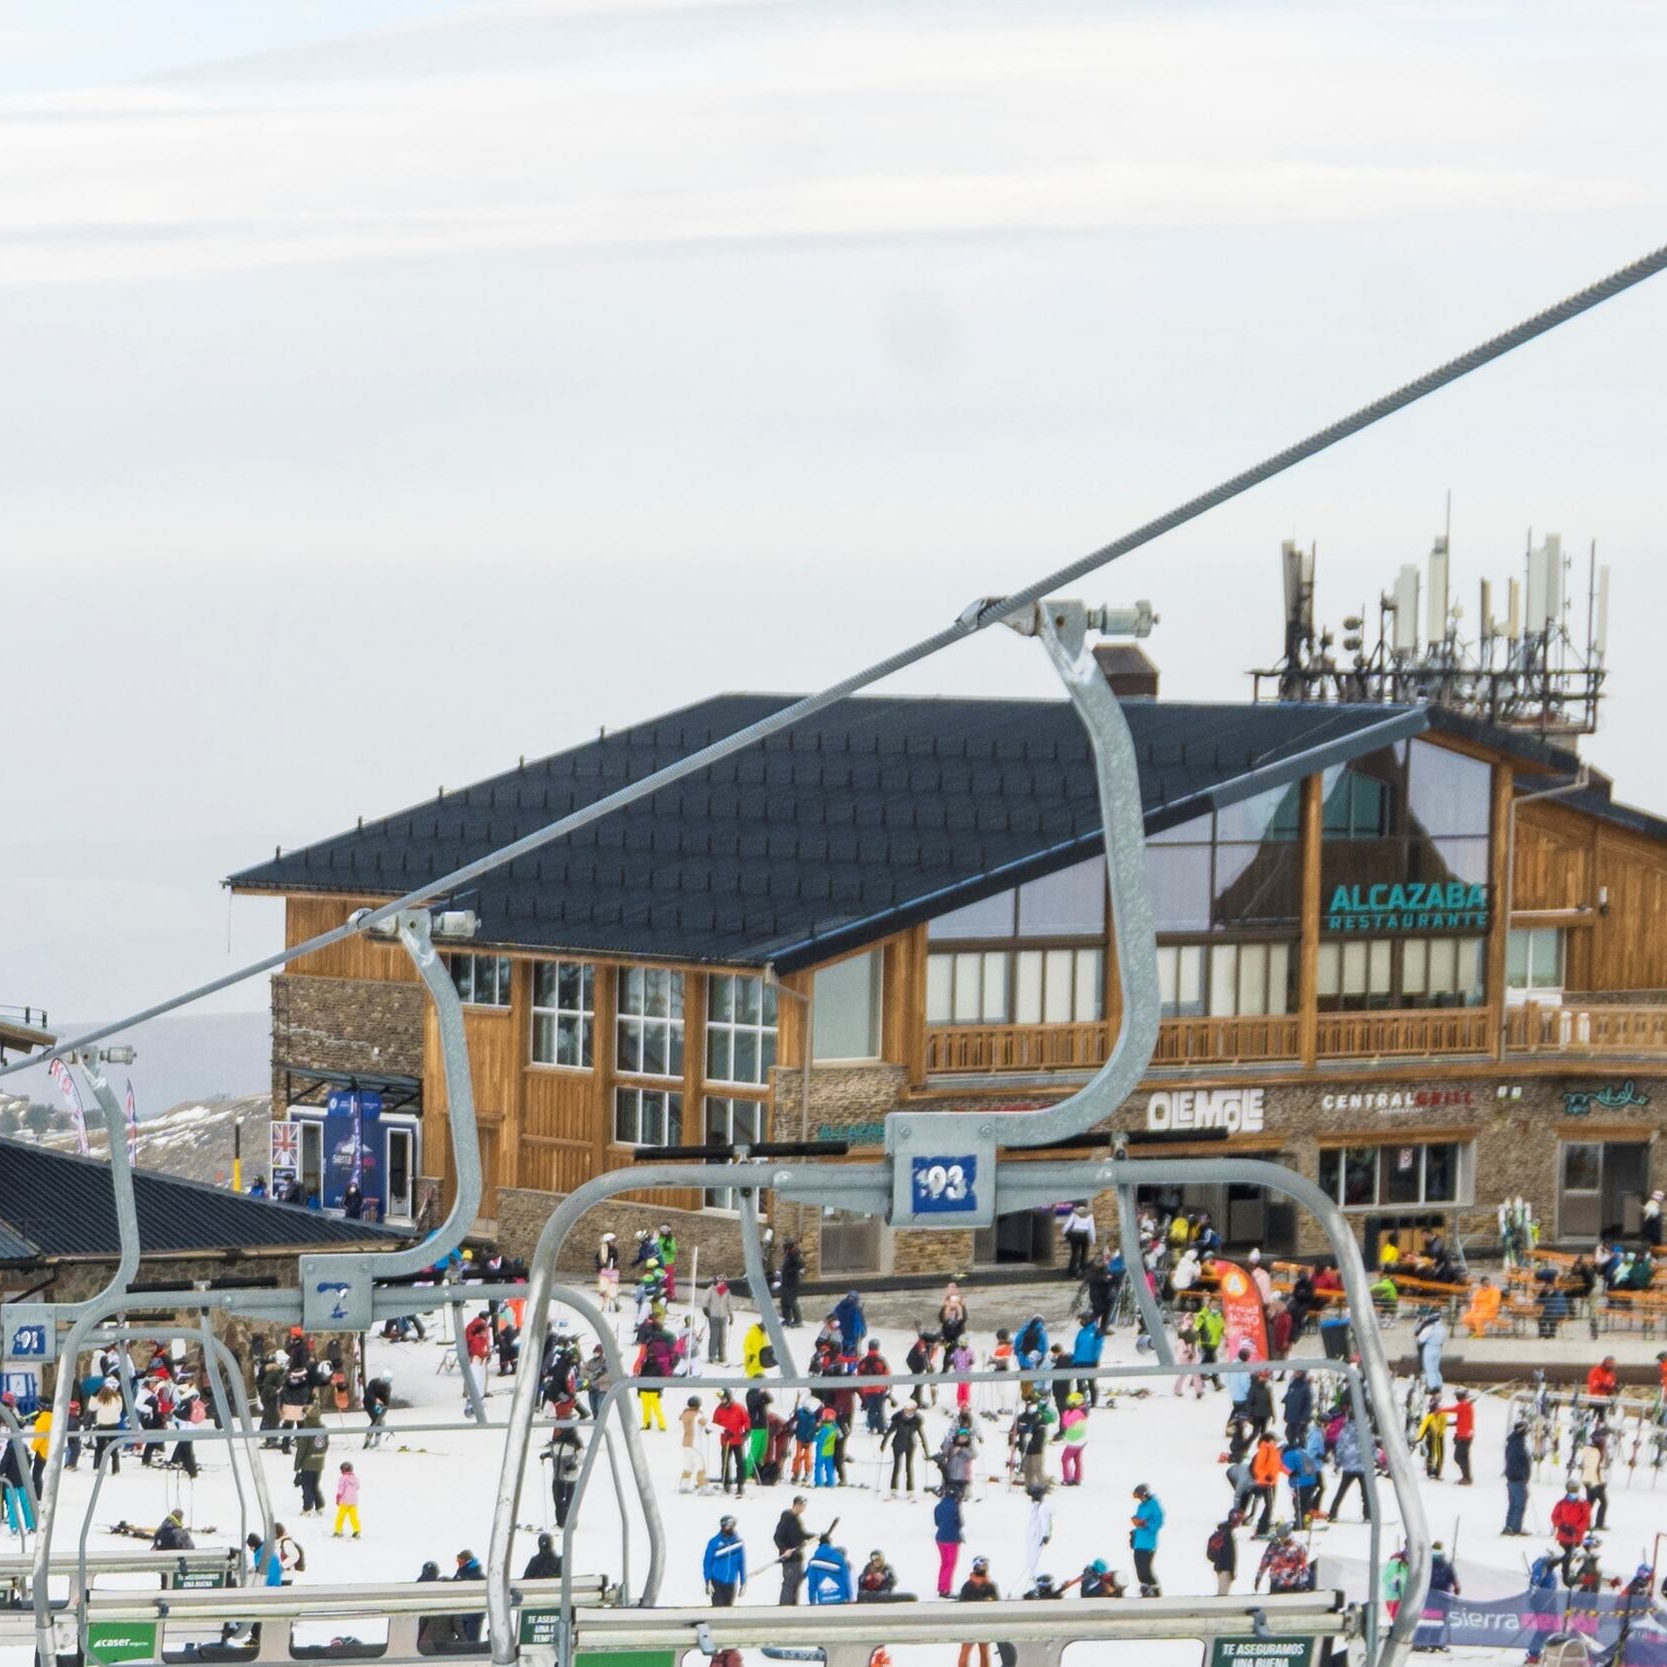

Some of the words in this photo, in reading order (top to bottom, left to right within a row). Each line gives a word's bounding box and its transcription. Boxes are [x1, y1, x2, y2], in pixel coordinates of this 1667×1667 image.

[1330, 883, 1487, 912] ALCAZABA
[1329, 913, 1487, 929] RESTAURANTE
[1322, 1091, 1415, 1109] CENTRAL
[1448, 1607, 1519, 1630] sierra
[101, 1638, 131, 1647] caser
[1222, 1644, 1236, 1656] TE
[1236, 1643, 1305, 1656] ASEGURAMOS
